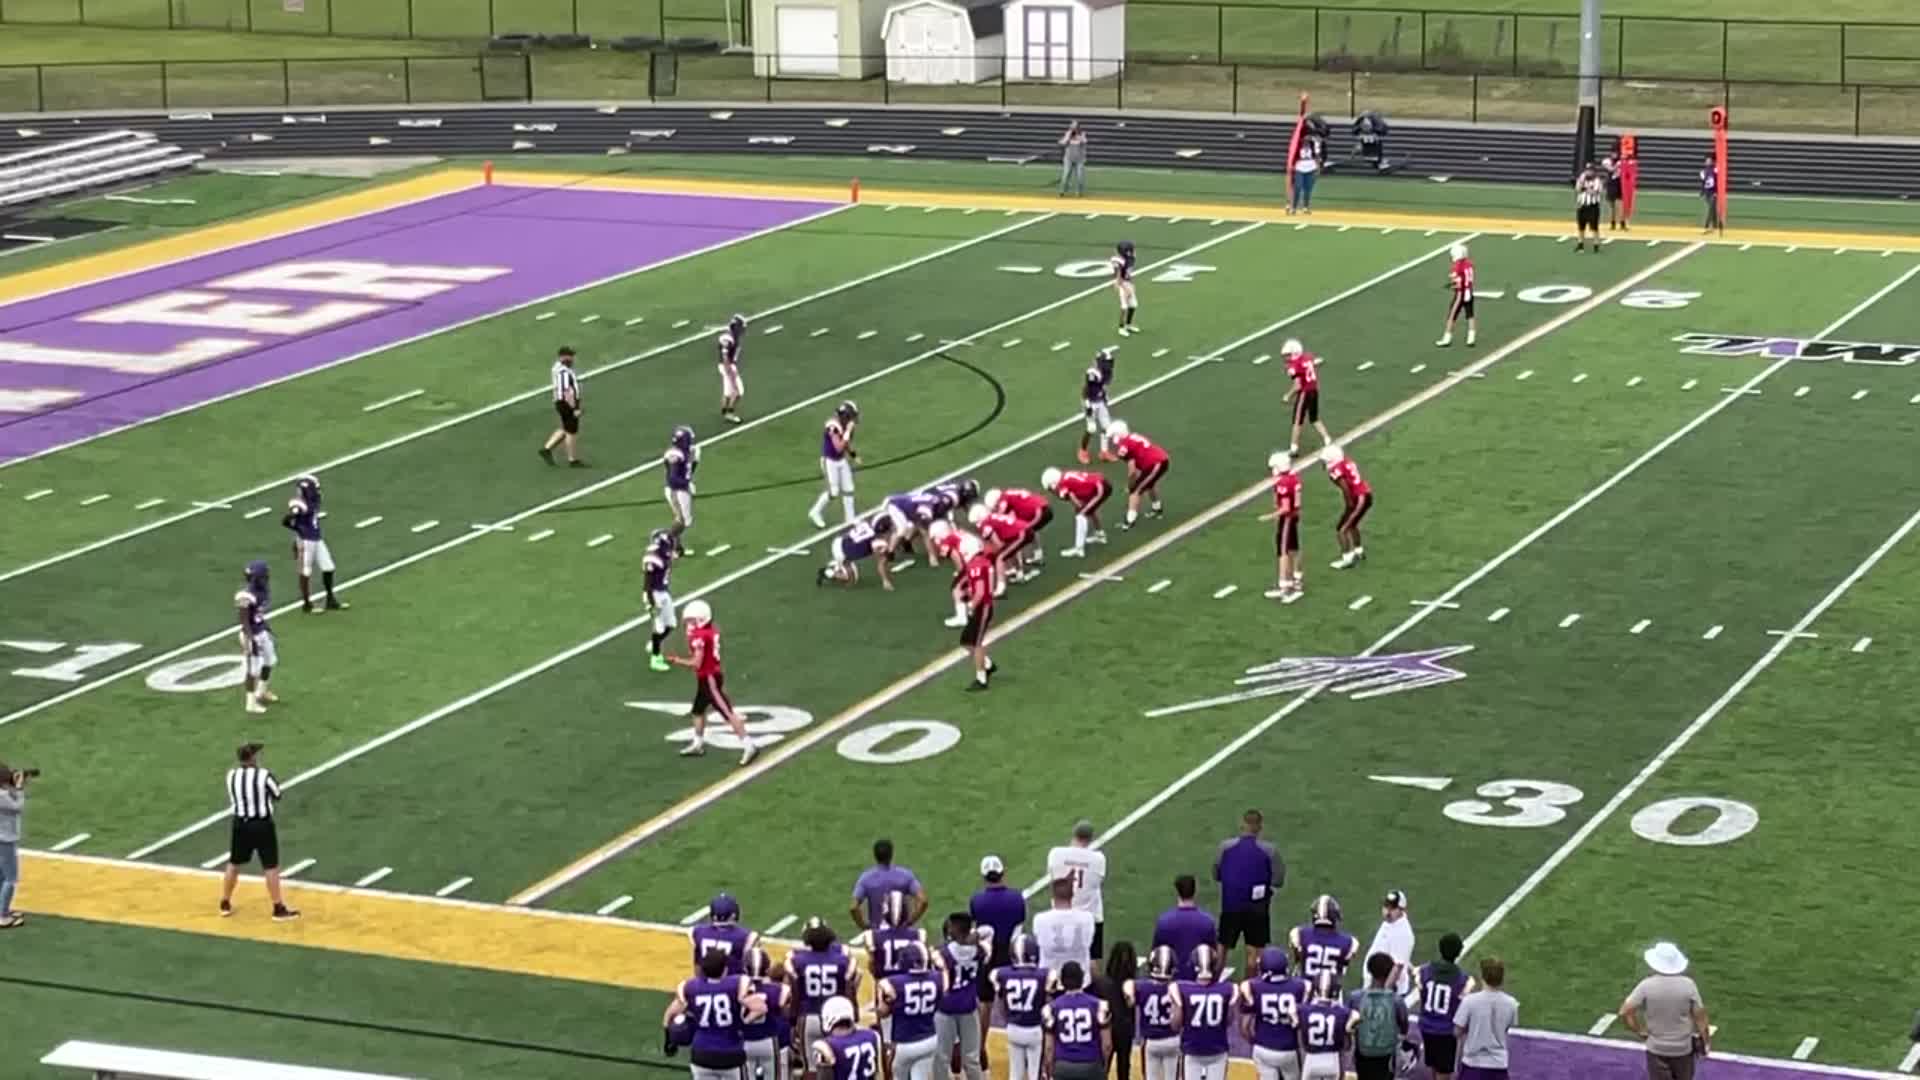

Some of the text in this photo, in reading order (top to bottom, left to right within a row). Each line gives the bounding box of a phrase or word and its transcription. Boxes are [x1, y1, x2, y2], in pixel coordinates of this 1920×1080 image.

[0, 260, 514, 414] LER
[1442, 779, 1760, 846] 30
[1305, 944, 1341, 976] 25
[804, 964, 838, 997] 65
[1006, 978, 1038, 1011] 27
[695, 993, 733, 1028] 78
[903, 981, 938, 1015] 52
[1189, 993, 1223, 1027] 70
[1423, 983, 1450, 1015] 10
[1058, 1008, 1093, 1043] 32
[1307, 1013, 1336, 1046] 21
[844, 1042, 876, 1080] 73
